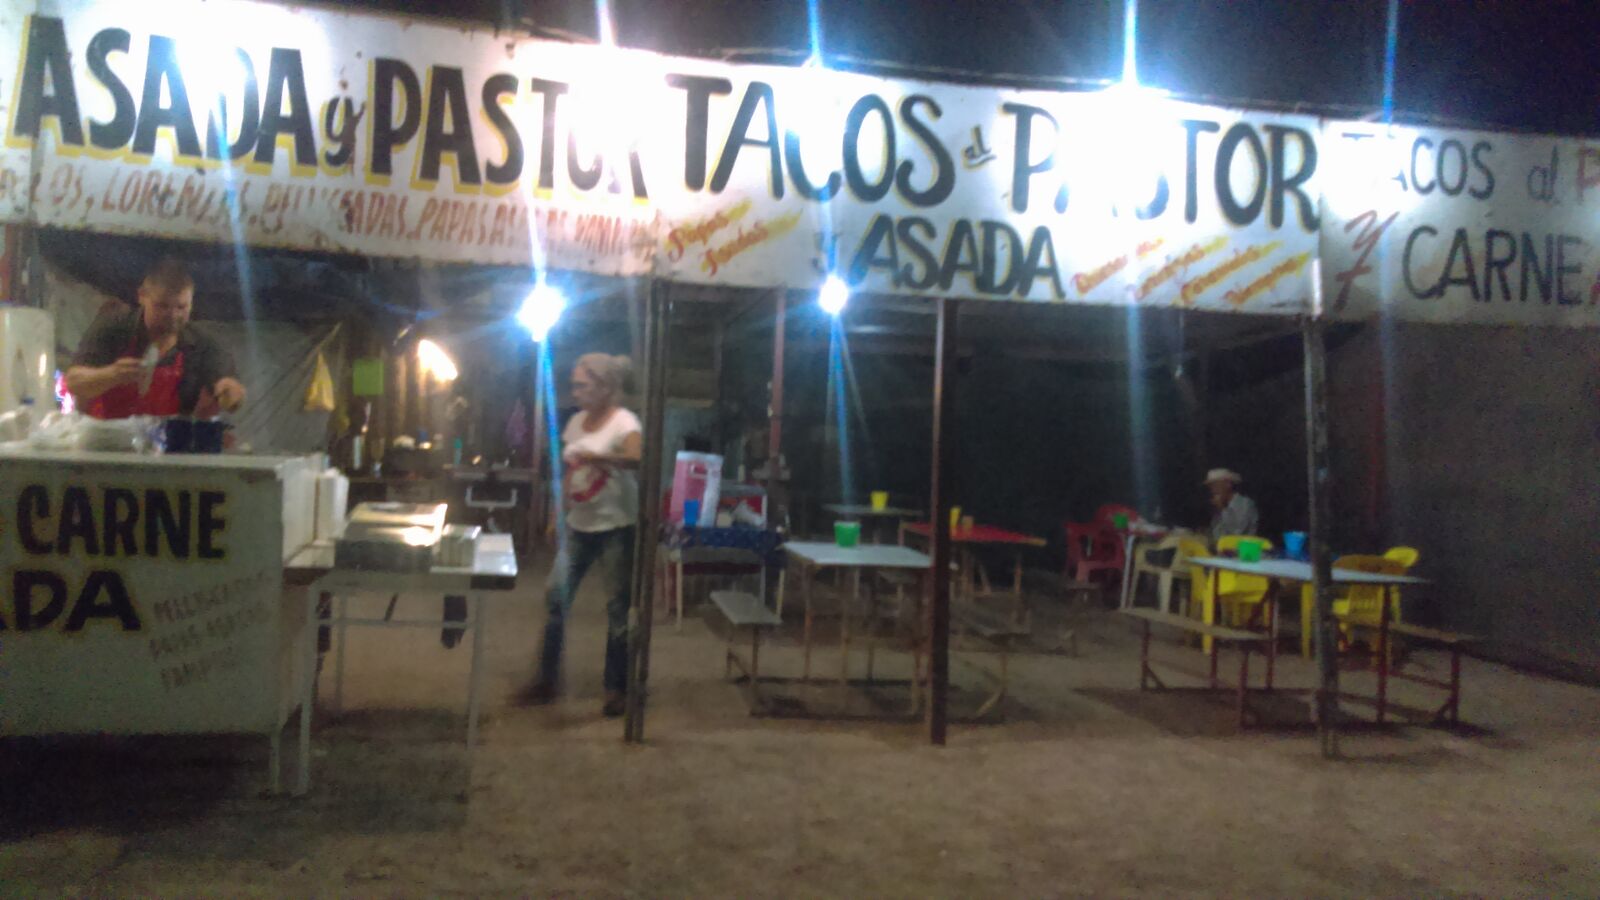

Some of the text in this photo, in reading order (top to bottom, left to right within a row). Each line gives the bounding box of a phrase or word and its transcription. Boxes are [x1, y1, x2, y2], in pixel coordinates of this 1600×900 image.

[13, 15, 318, 167] ASADA
[666, 73, 955, 207] TACOS
[1002, 102, 1320, 232] PTOR
[848, 213, 1064, 303] ASADA
[1402, 225, 1583, 305] CARNE
[16, 484, 226, 559] CARNE
[0, 569, 142, 632] DA
